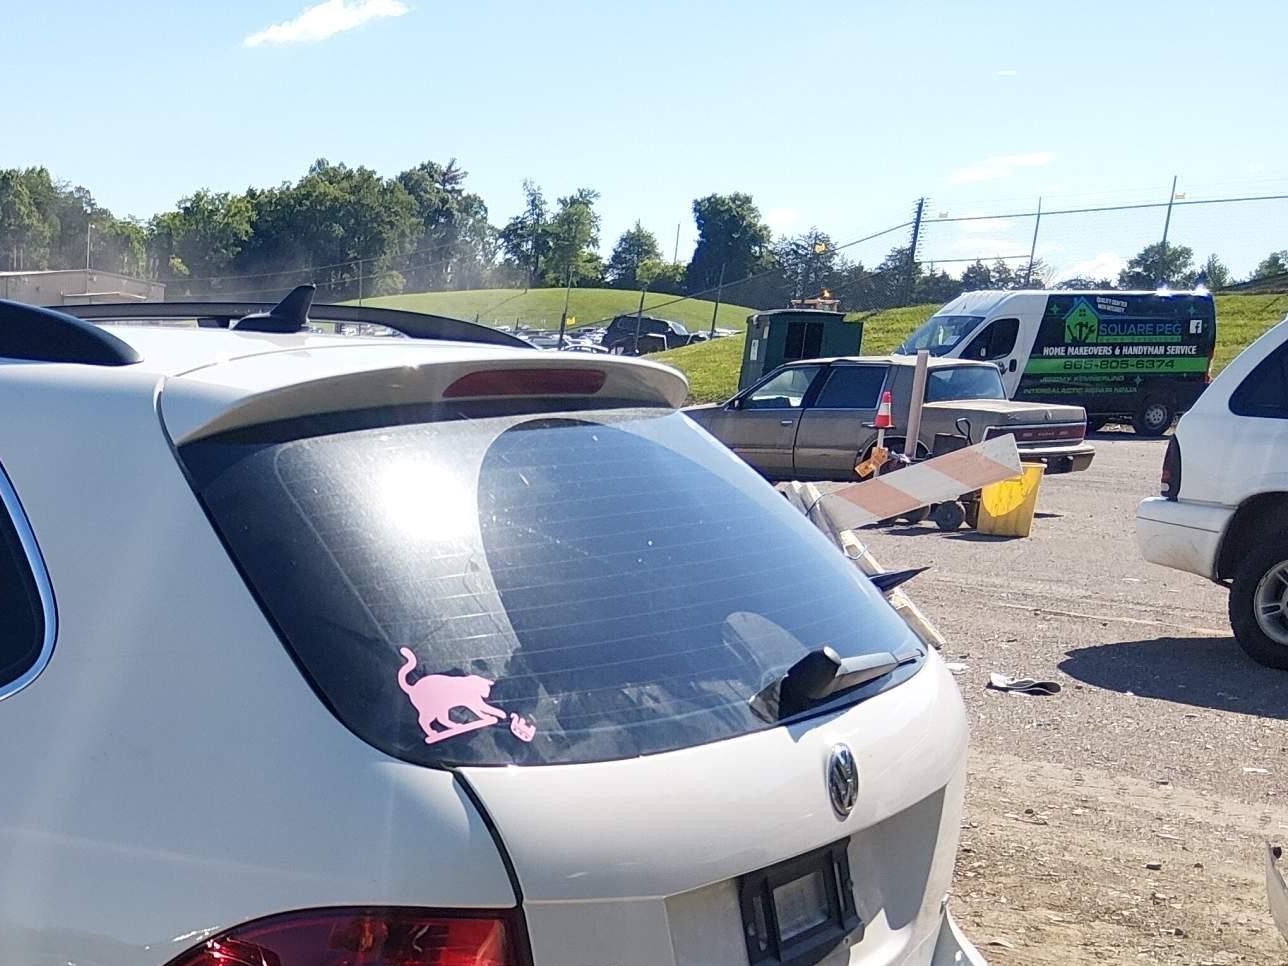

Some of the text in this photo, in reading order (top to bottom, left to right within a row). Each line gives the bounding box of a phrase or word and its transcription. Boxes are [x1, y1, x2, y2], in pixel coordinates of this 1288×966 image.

[1099, 323, 1182, 335] SQUARE PEG
[1042, 344, 1197, 356] HOME MAKEOVERS & HANDYMAN SERVICE
[1063, 359, 1176, 370] 865-805-6374
